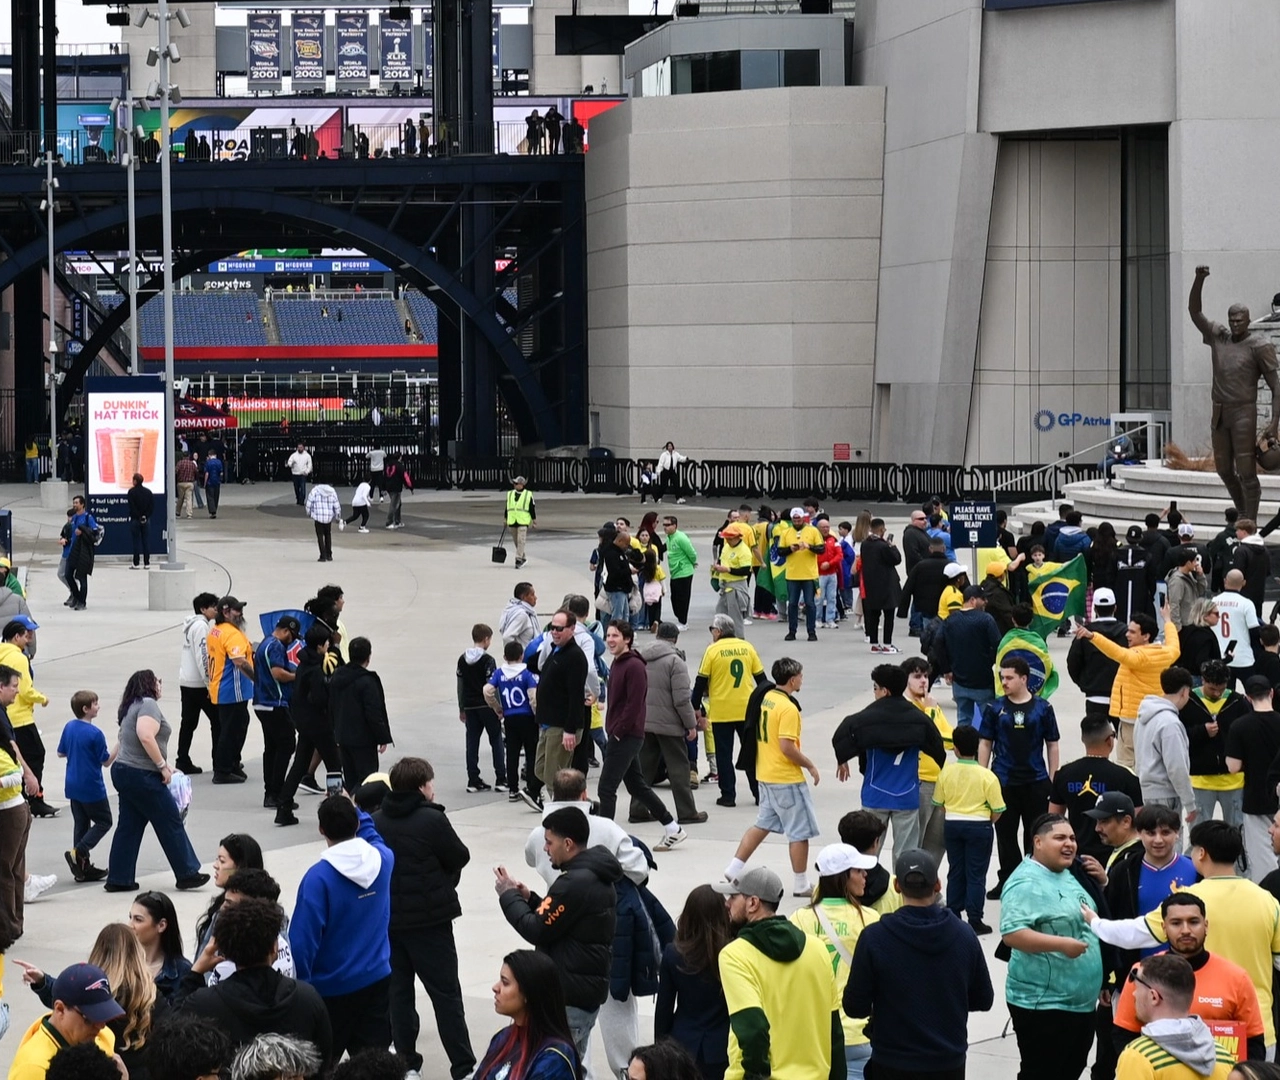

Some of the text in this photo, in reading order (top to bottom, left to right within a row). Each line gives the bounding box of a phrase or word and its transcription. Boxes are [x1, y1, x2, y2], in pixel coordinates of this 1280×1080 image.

[214, 139, 249, 151] ROA
[104, 401, 150, 409] DUNKIN'
[94, 411, 158, 420] HAT TRICK
[174, 418, 226, 428] ORMATION
[1221, 612, 1230, 638] 6
[720, 648, 749, 657] RONALDO
[730, 658, 744, 688] 9
[502, 686, 525, 708] 10
[544, 904, 565, 925] vivo
[1198, 996, 1223, 1004] boost
